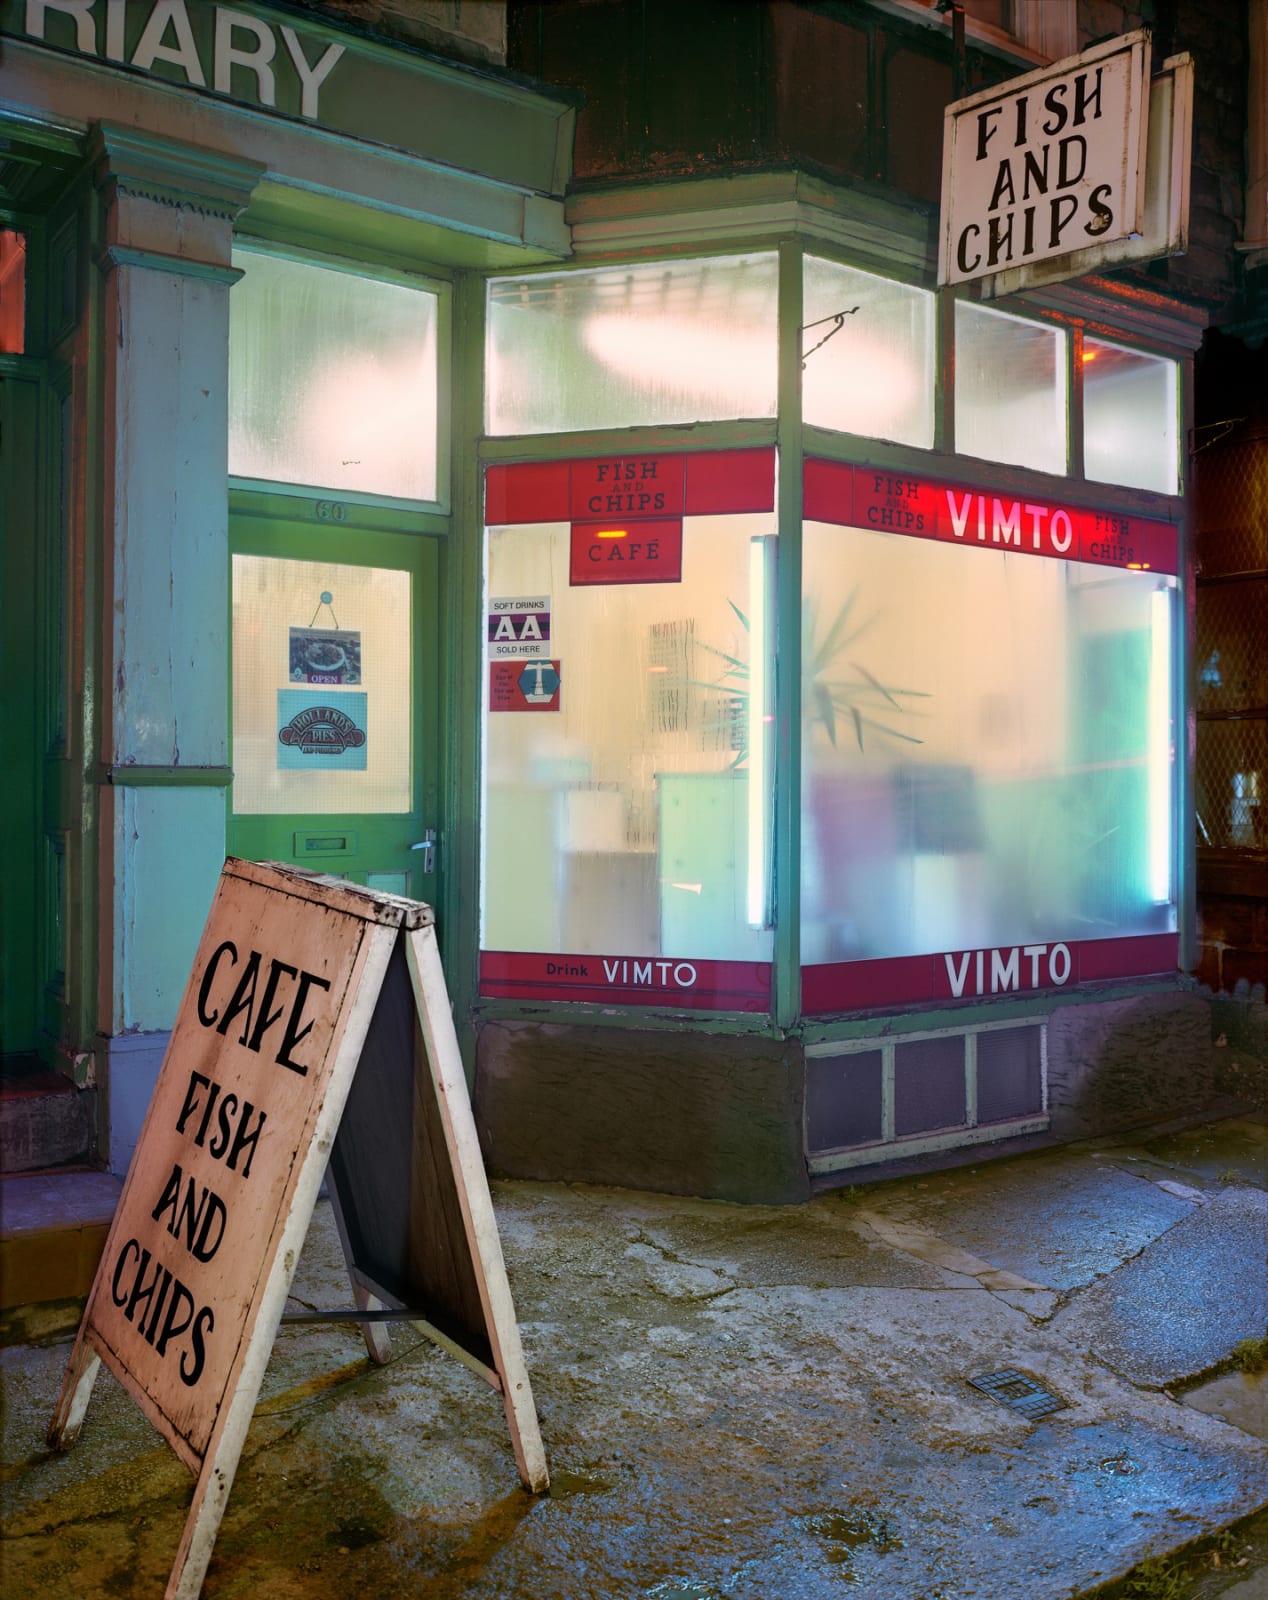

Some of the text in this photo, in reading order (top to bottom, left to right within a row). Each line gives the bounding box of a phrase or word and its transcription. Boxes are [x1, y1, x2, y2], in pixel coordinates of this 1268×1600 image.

[976, 67, 1104, 161] FISH
[987, 134, 1088, 212] AND
[957, 184, 1114, 274] CHIPS
[596, 461, 659, 482] FISH
[612, 482, 645, 493] AND
[874, 475, 920, 500] FISH
[316, 502, 346, 521] 60
[588, 493, 666, 513] CHIPS
[886, 498, 909, 511] AND
[867, 506, 925, 531] CHIPS
[945, 489, 1073, 553] VIMTO
[1095, 515, 1130, 536] FISH
[1090, 542, 1135, 562] CHIPS
[1103, 534, 1123, 546] AND
[516, 601, 544, 609] DRINKS
[493, 616, 543, 640] AA
[311, 674, 338, 683] OPEN
[311, 729, 336, 743] PIES
[546, 959, 698, 987] Drink VIMTO
[944, 943, 1072, 998] VIMTO
[197, 941, 331, 1077] CAFE
[175, 1070, 267, 1179] FISH
[151, 1164, 228, 1264] AND
[111, 1238, 214, 1387] CHIPS
